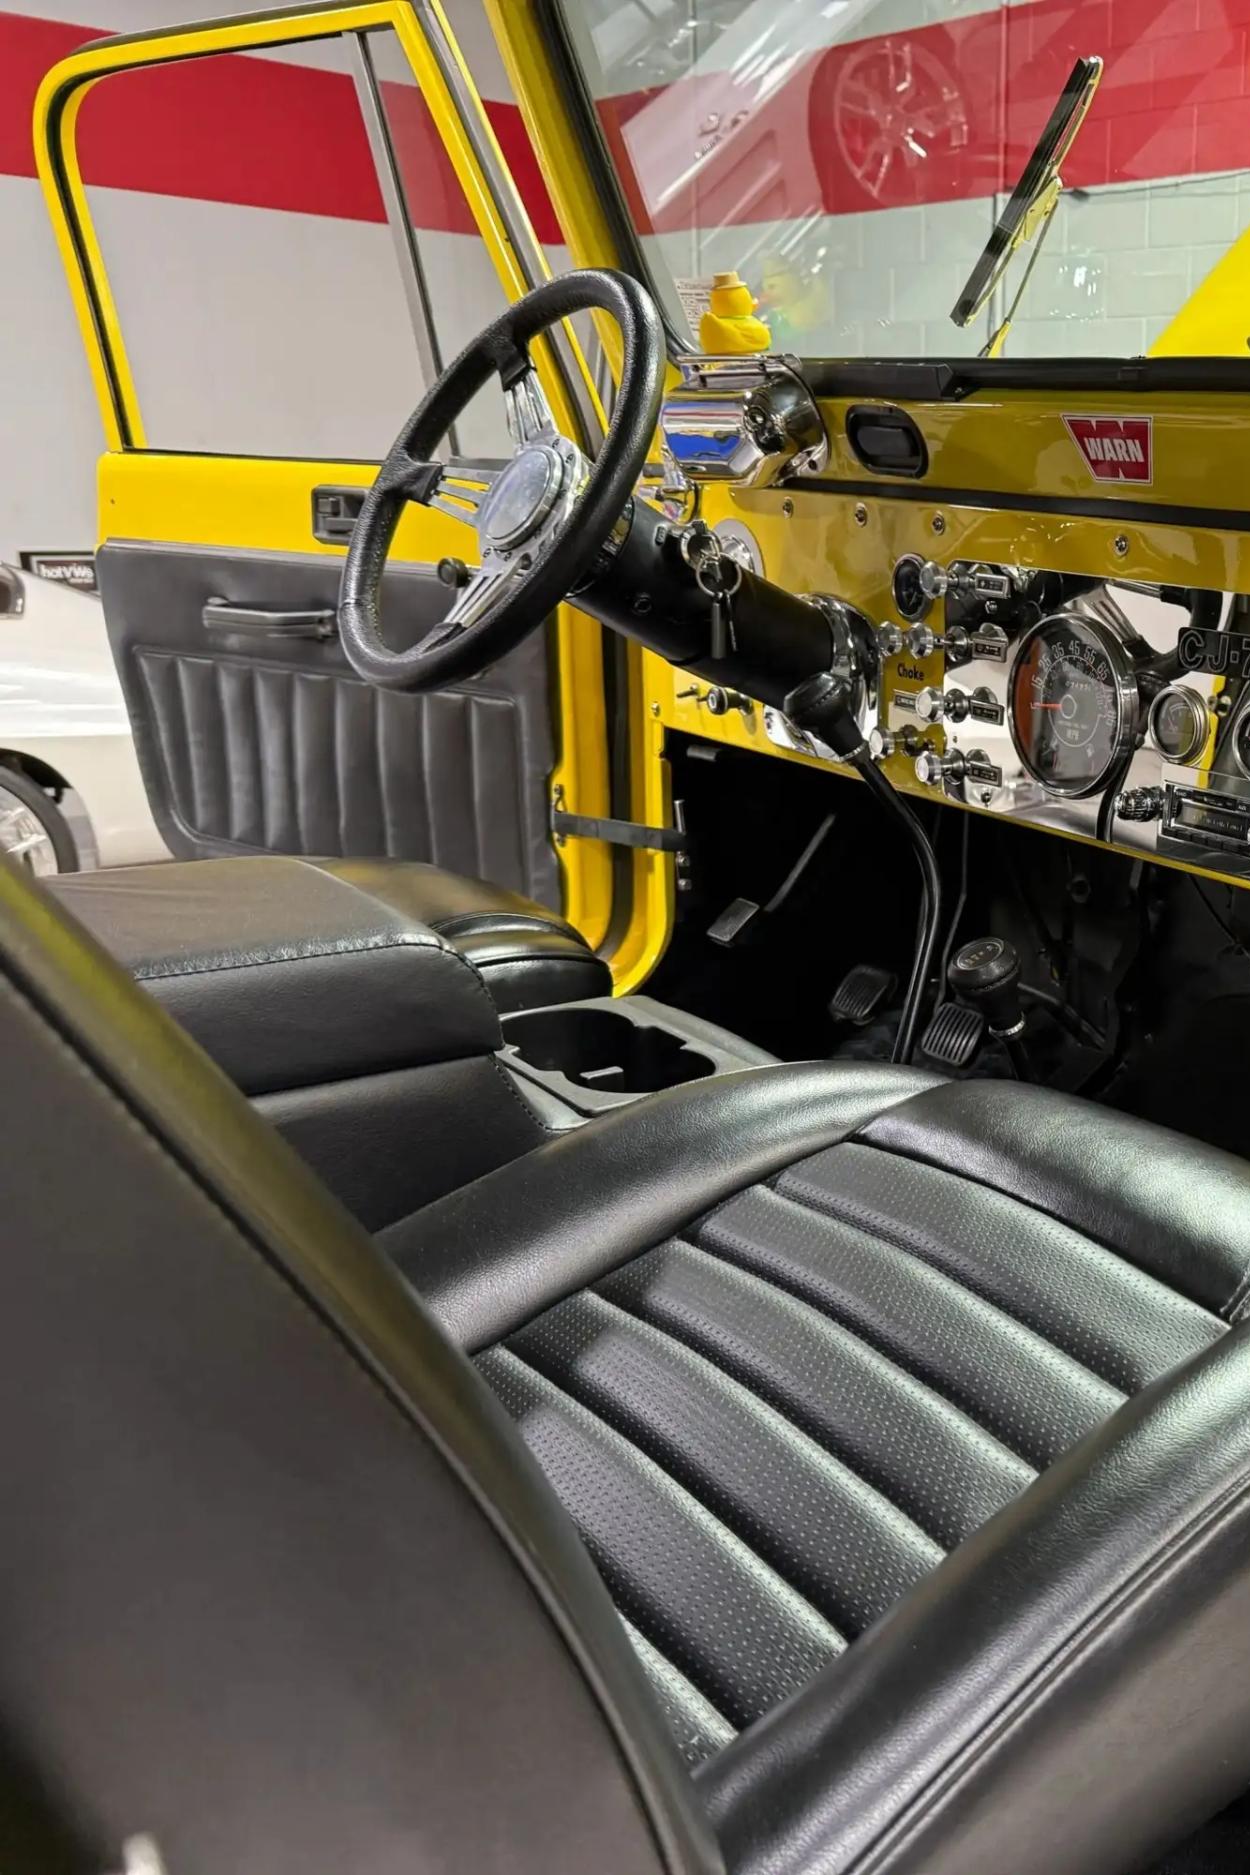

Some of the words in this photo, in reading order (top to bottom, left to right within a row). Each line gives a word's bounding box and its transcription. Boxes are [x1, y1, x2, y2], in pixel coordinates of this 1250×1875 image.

[1084, 437, 1145, 463] WARN
[1051, 641, 1065, 660] 35
[1068, 639, 1081, 655] 45
[897, 662, 925, 681] Choke
